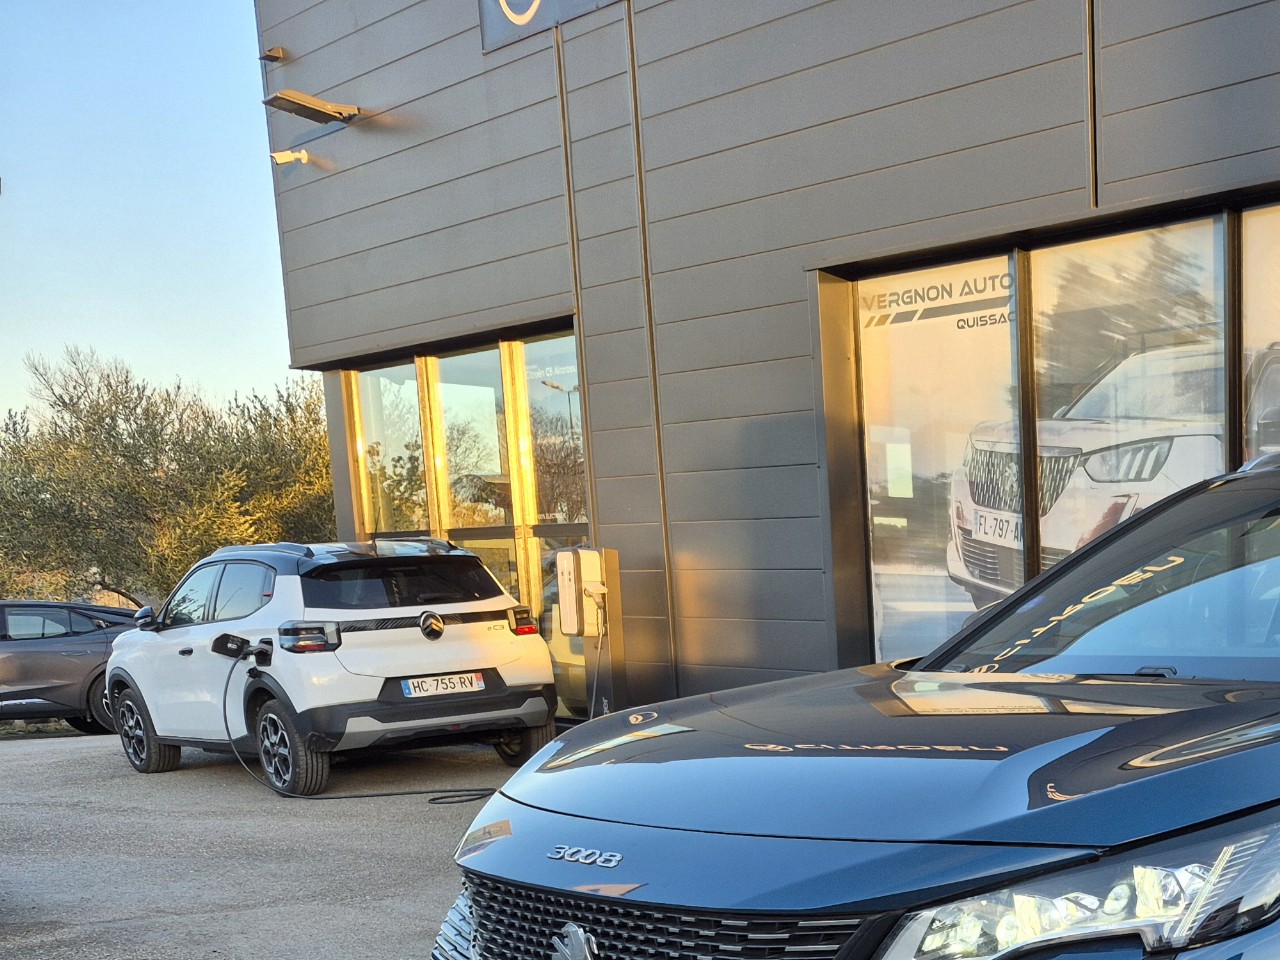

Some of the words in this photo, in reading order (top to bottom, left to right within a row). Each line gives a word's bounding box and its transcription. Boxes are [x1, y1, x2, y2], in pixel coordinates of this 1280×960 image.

[862, 282, 953, 311] VERGNON
[959, 272, 1015, 297] AUTO
[546, 845, 624, 868] 3008
